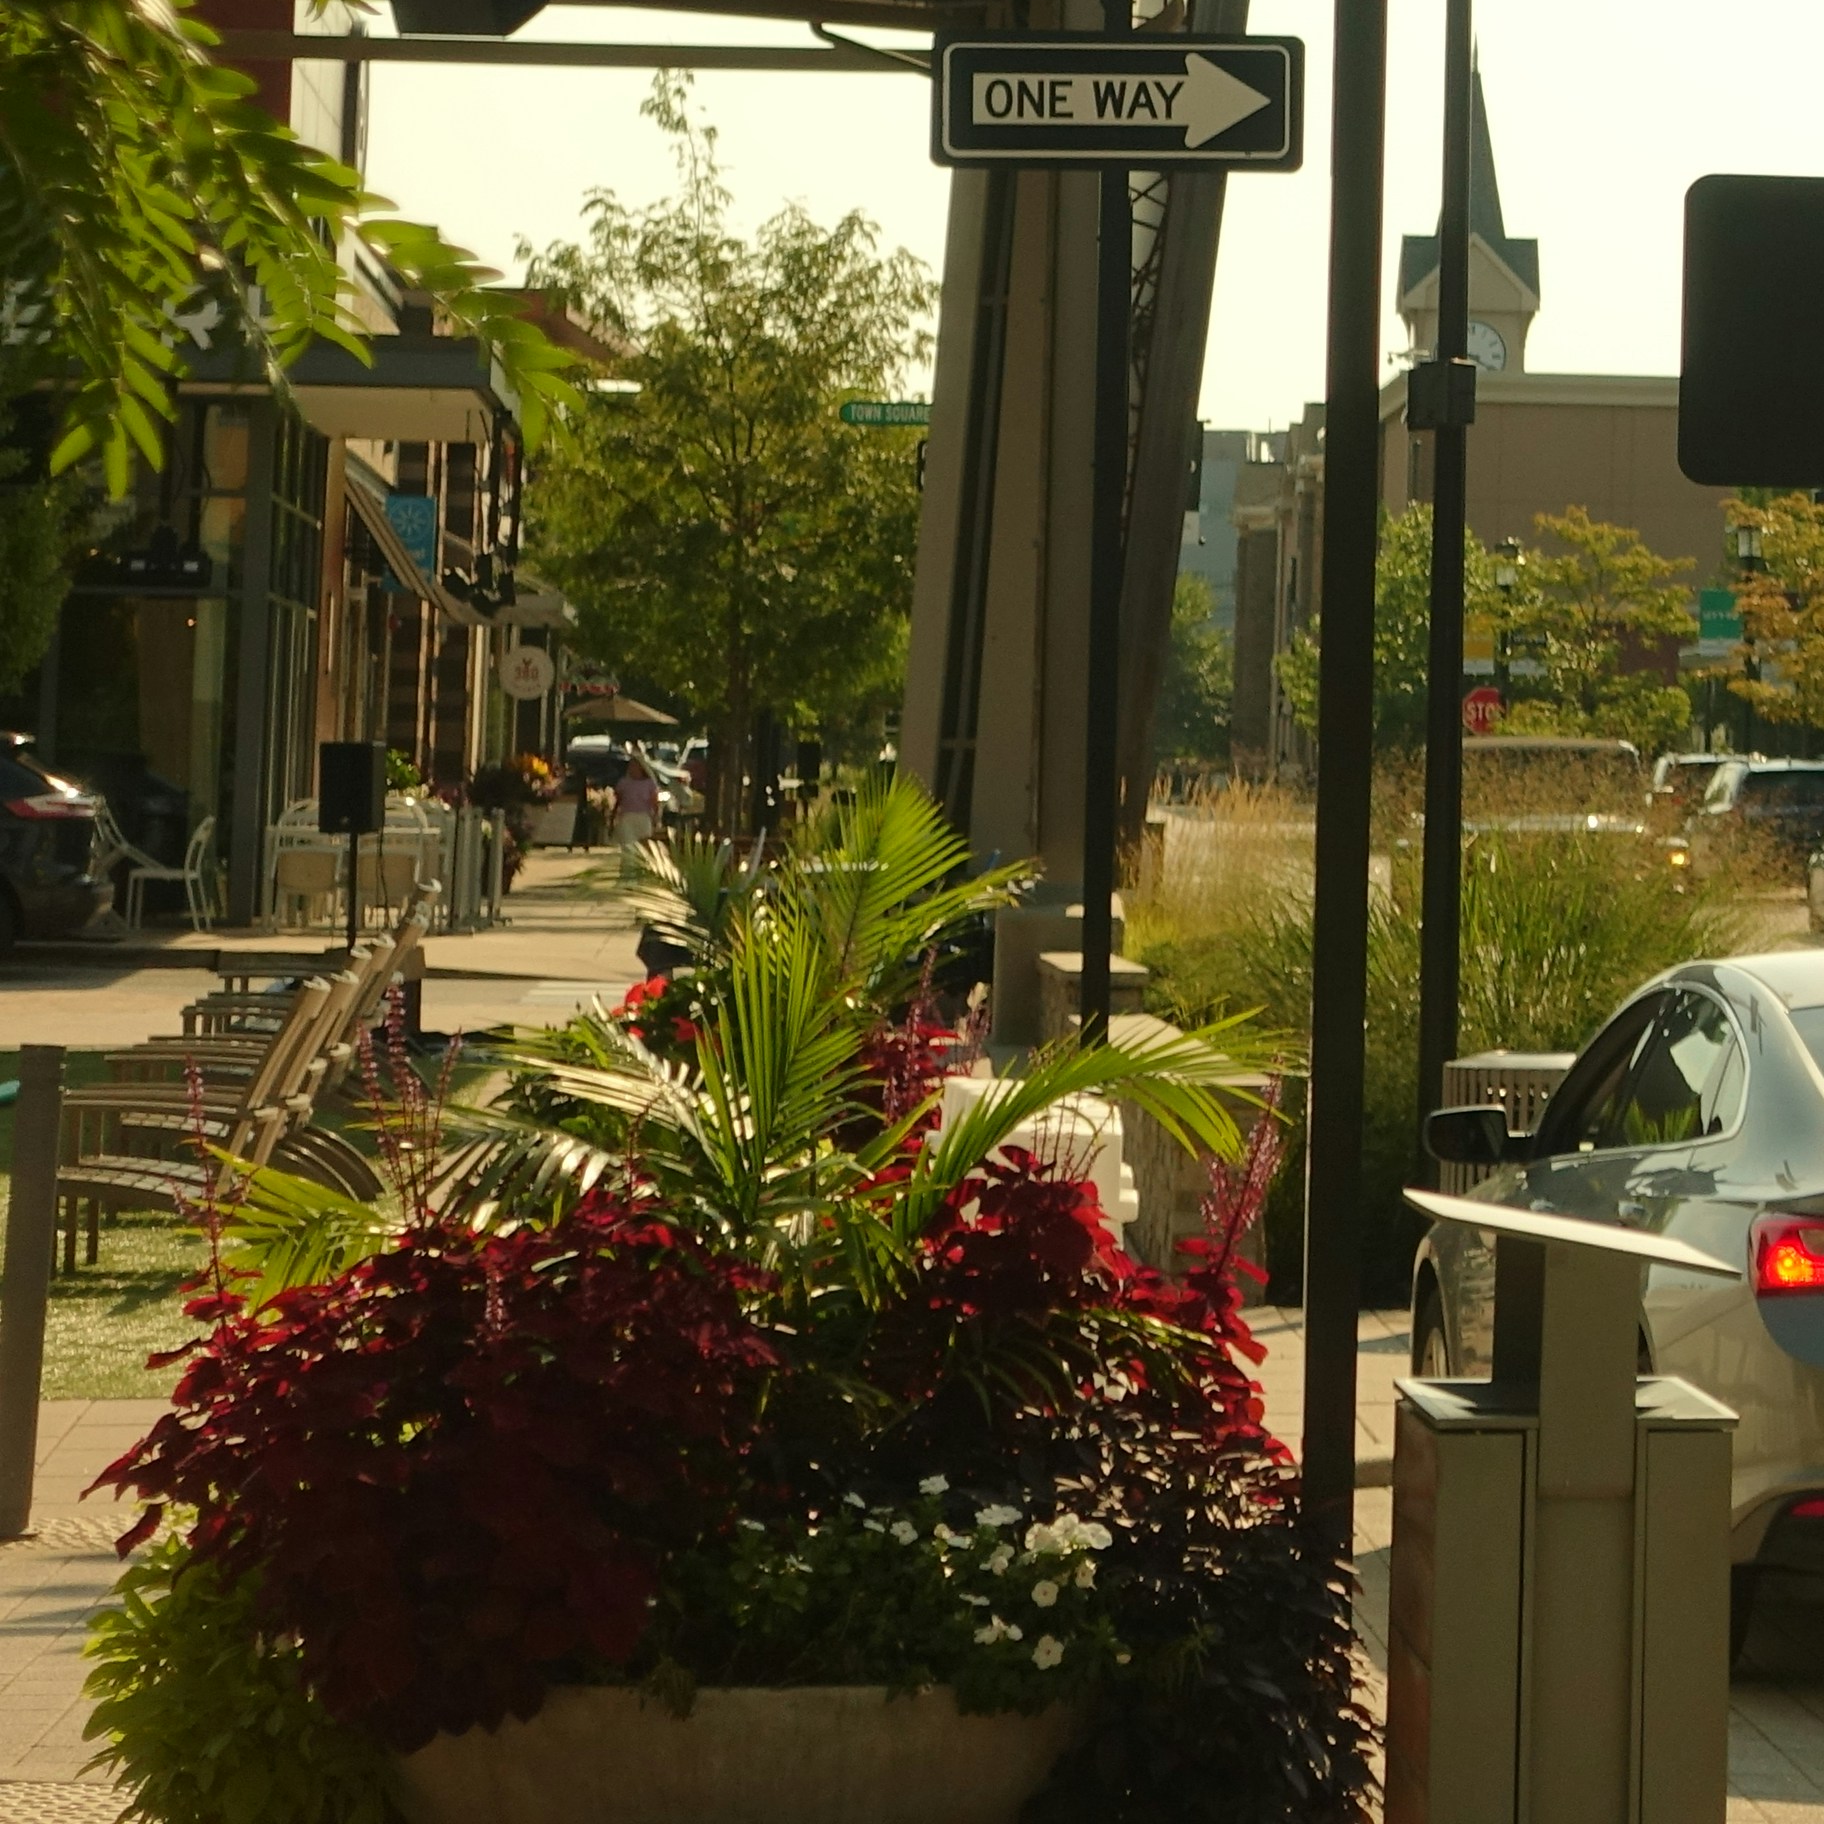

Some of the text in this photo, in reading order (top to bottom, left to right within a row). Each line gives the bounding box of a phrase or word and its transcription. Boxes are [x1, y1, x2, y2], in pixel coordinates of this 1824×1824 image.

[985, 79, 1184, 119] ONE WAY
[850, 404, 881, 422] TOWN
